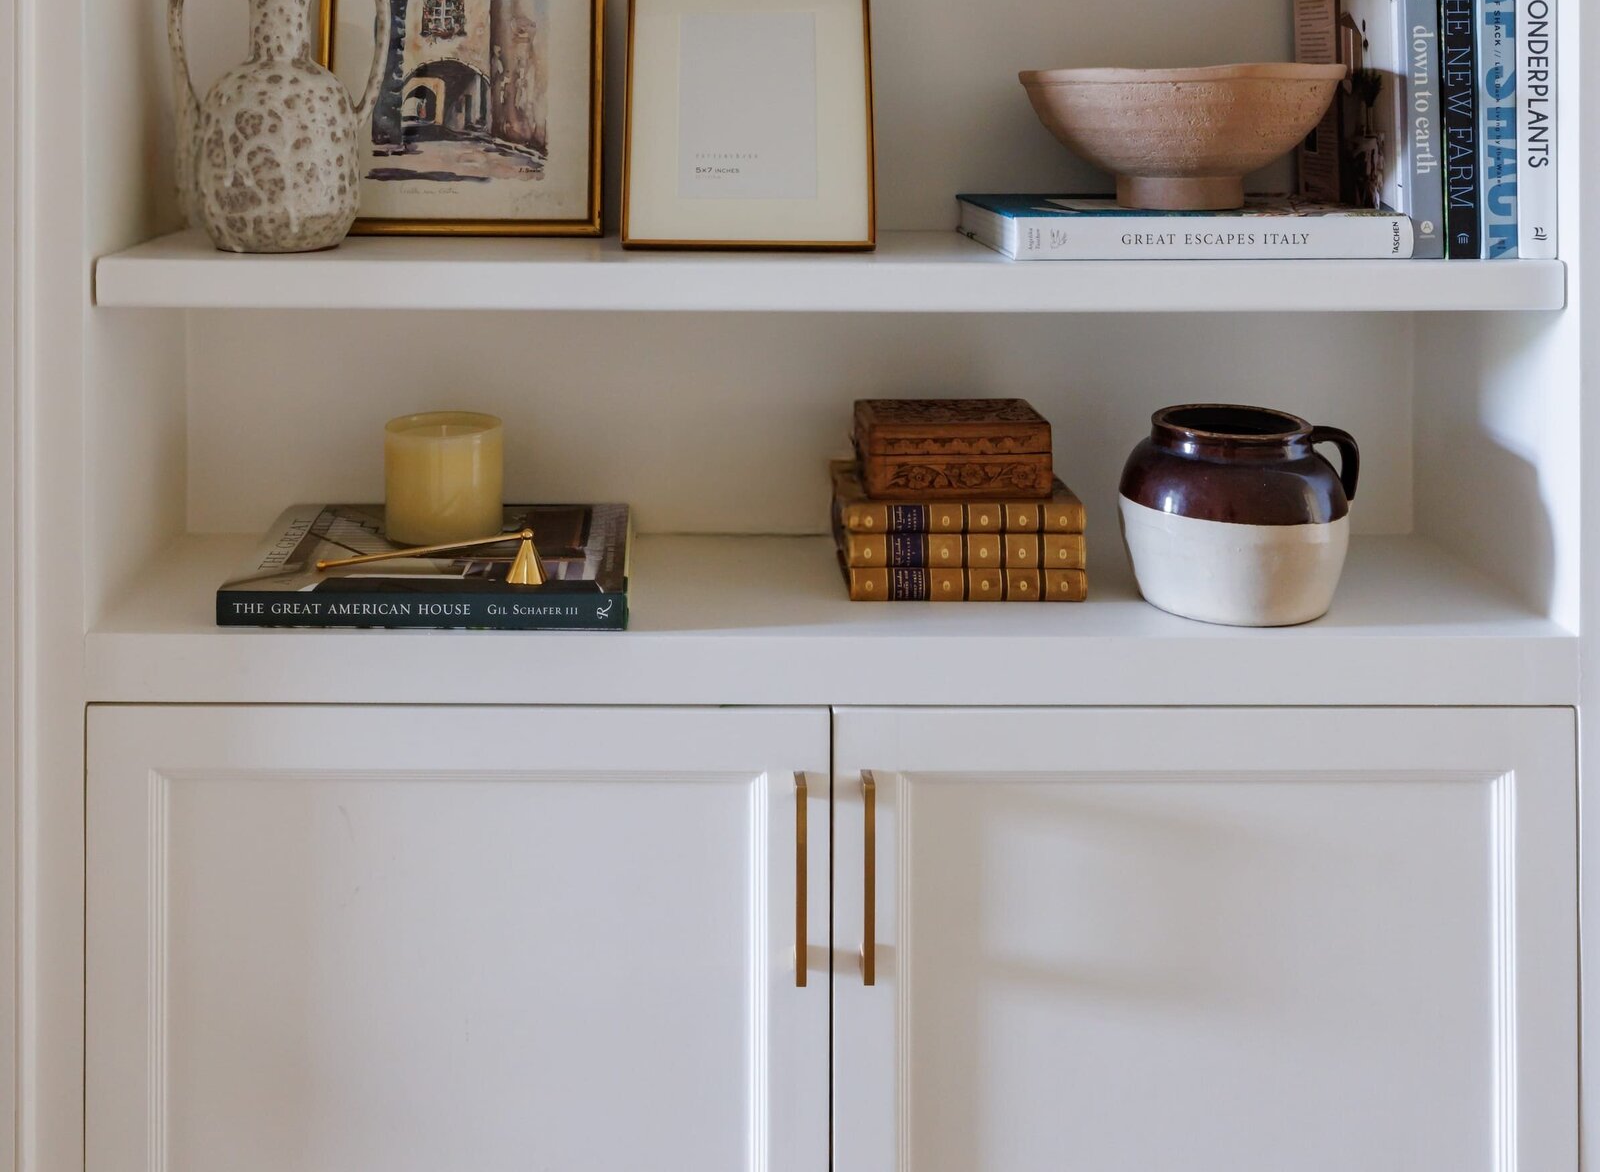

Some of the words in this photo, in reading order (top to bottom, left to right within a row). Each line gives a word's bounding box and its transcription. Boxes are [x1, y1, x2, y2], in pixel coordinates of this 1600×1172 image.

[1493, 10, 1502, 46] SHACK
[1412, 25, 1434, 85] down
[1414, 91, 1432, 113] to
[1447, 46, 1473, 118] NEW
[1415, 117, 1438, 174] earth
[1448, 127, 1474, 209] FARM
[1121, 233, 1176, 245] GREAT
[1184, 233, 1255, 245] ESCAPES
[1263, 233, 1310, 245] ITALY
[1391, 221, 1400, 254] TASCHEN
[257, 550, 290, 570] THE
[275, 519, 313, 549] GREAT
[232, 602, 264, 614] THE
[271, 603, 322, 615] GREAT
[328, 603, 411, 615] AMERICAN
[419, 604, 471, 616] HOUSE
